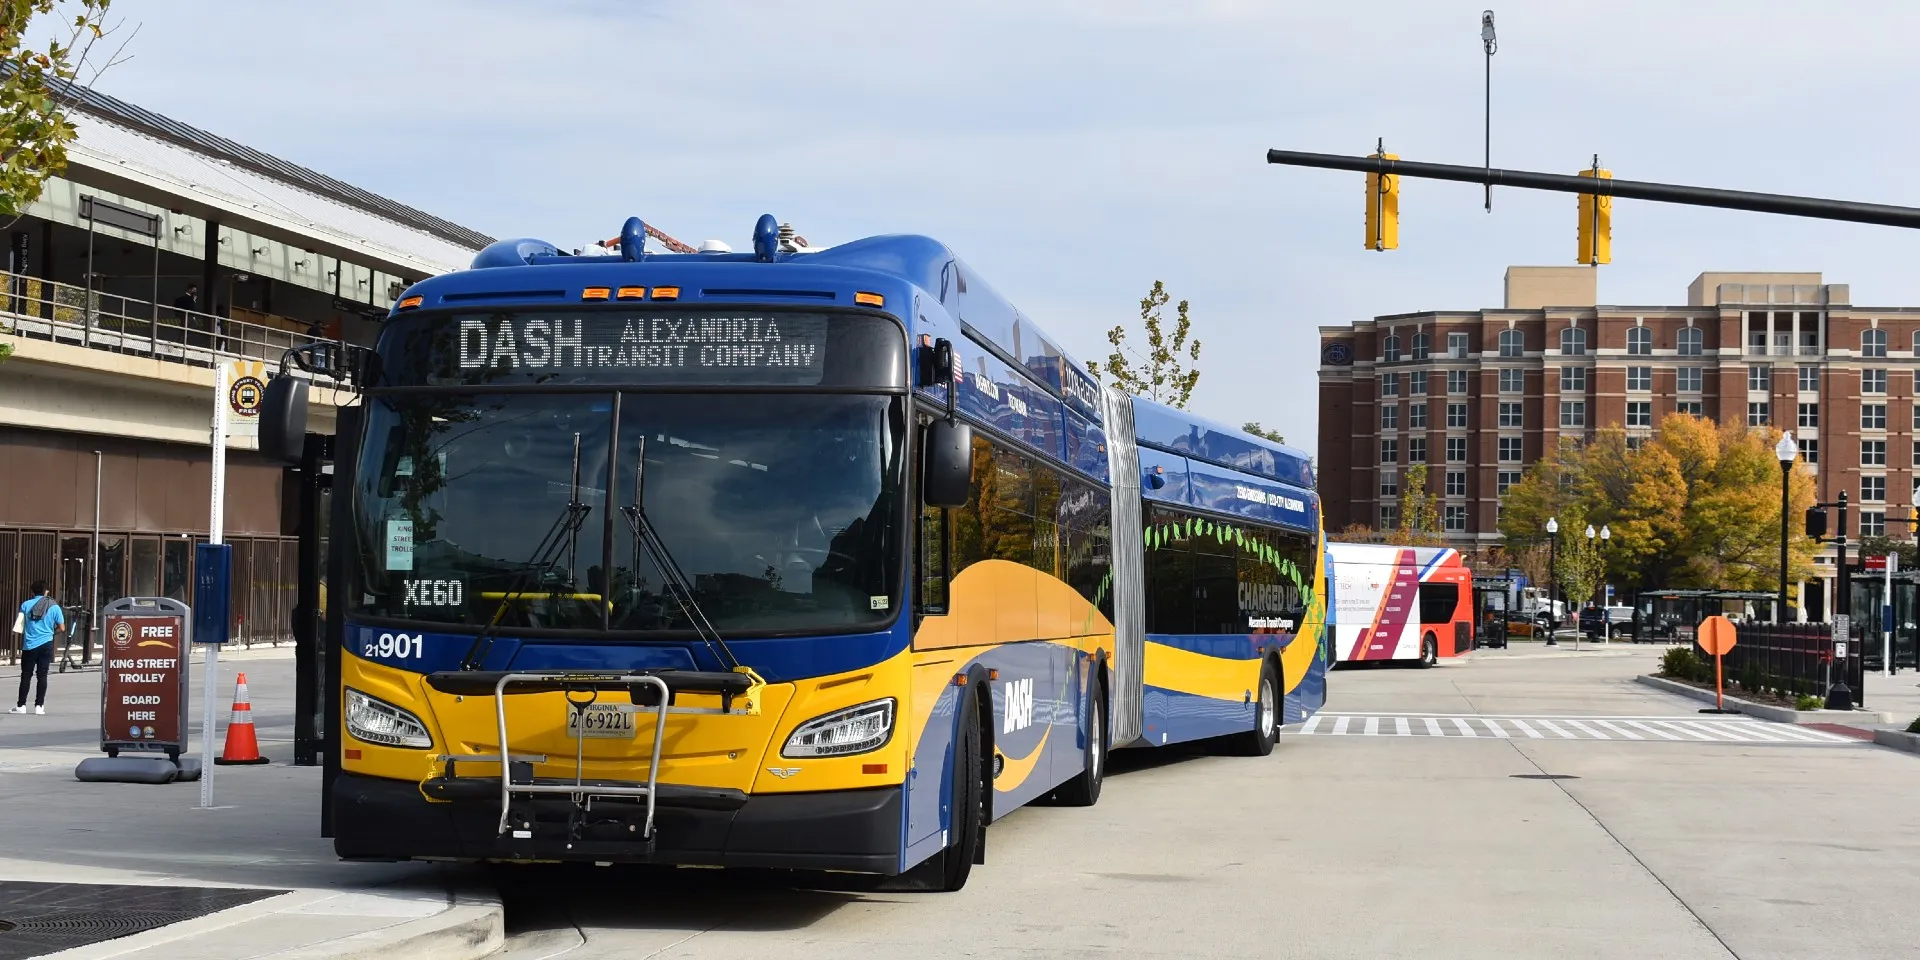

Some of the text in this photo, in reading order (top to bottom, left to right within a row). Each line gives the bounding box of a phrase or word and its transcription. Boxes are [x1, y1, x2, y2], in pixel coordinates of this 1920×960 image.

[620, 318, 781, 343] ALEXANDRIA
[460, 320, 582, 368] DASH
[583, 344, 815, 367] TRANSIT COMPANY
[403, 579, 462, 606] XE60
[1238, 581, 1299, 613] CHARGED UP
[141, 626, 173, 638] FREE
[109, 658, 177, 669] KING STREET
[118, 673, 166, 683] TROLLEY
[122, 695, 161, 705] BOARD
[585, 704, 618, 712] VIRGINIA
[1003, 677, 1033, 735] DASH
[127, 711, 156, 721] HERE
